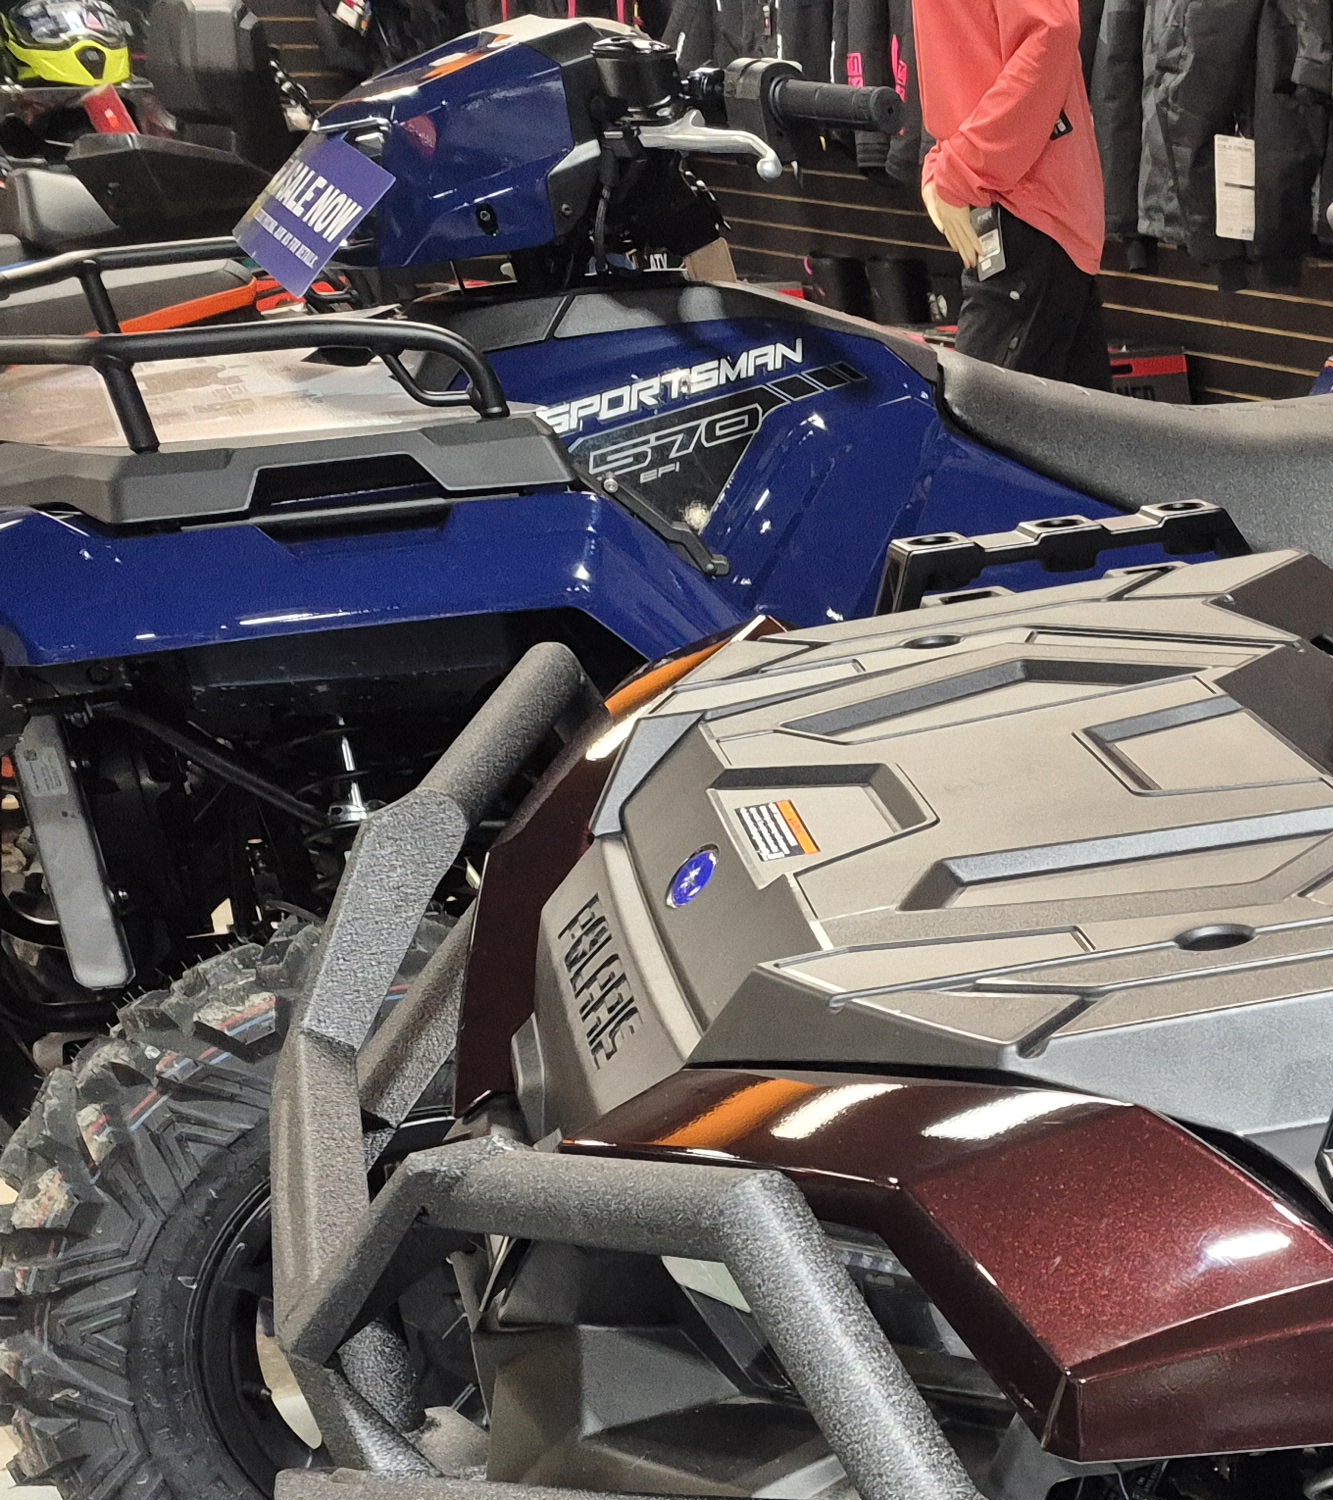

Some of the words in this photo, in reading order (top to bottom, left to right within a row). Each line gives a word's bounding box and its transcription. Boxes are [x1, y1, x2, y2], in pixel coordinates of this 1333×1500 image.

[302, 185, 363, 242] NOW
[537, 338, 803, 434] SPORTSMAN
[589, 403, 763, 475] 570
[640, 461, 680, 484] EFI
[557, 892, 644, 1071] POLARIS
